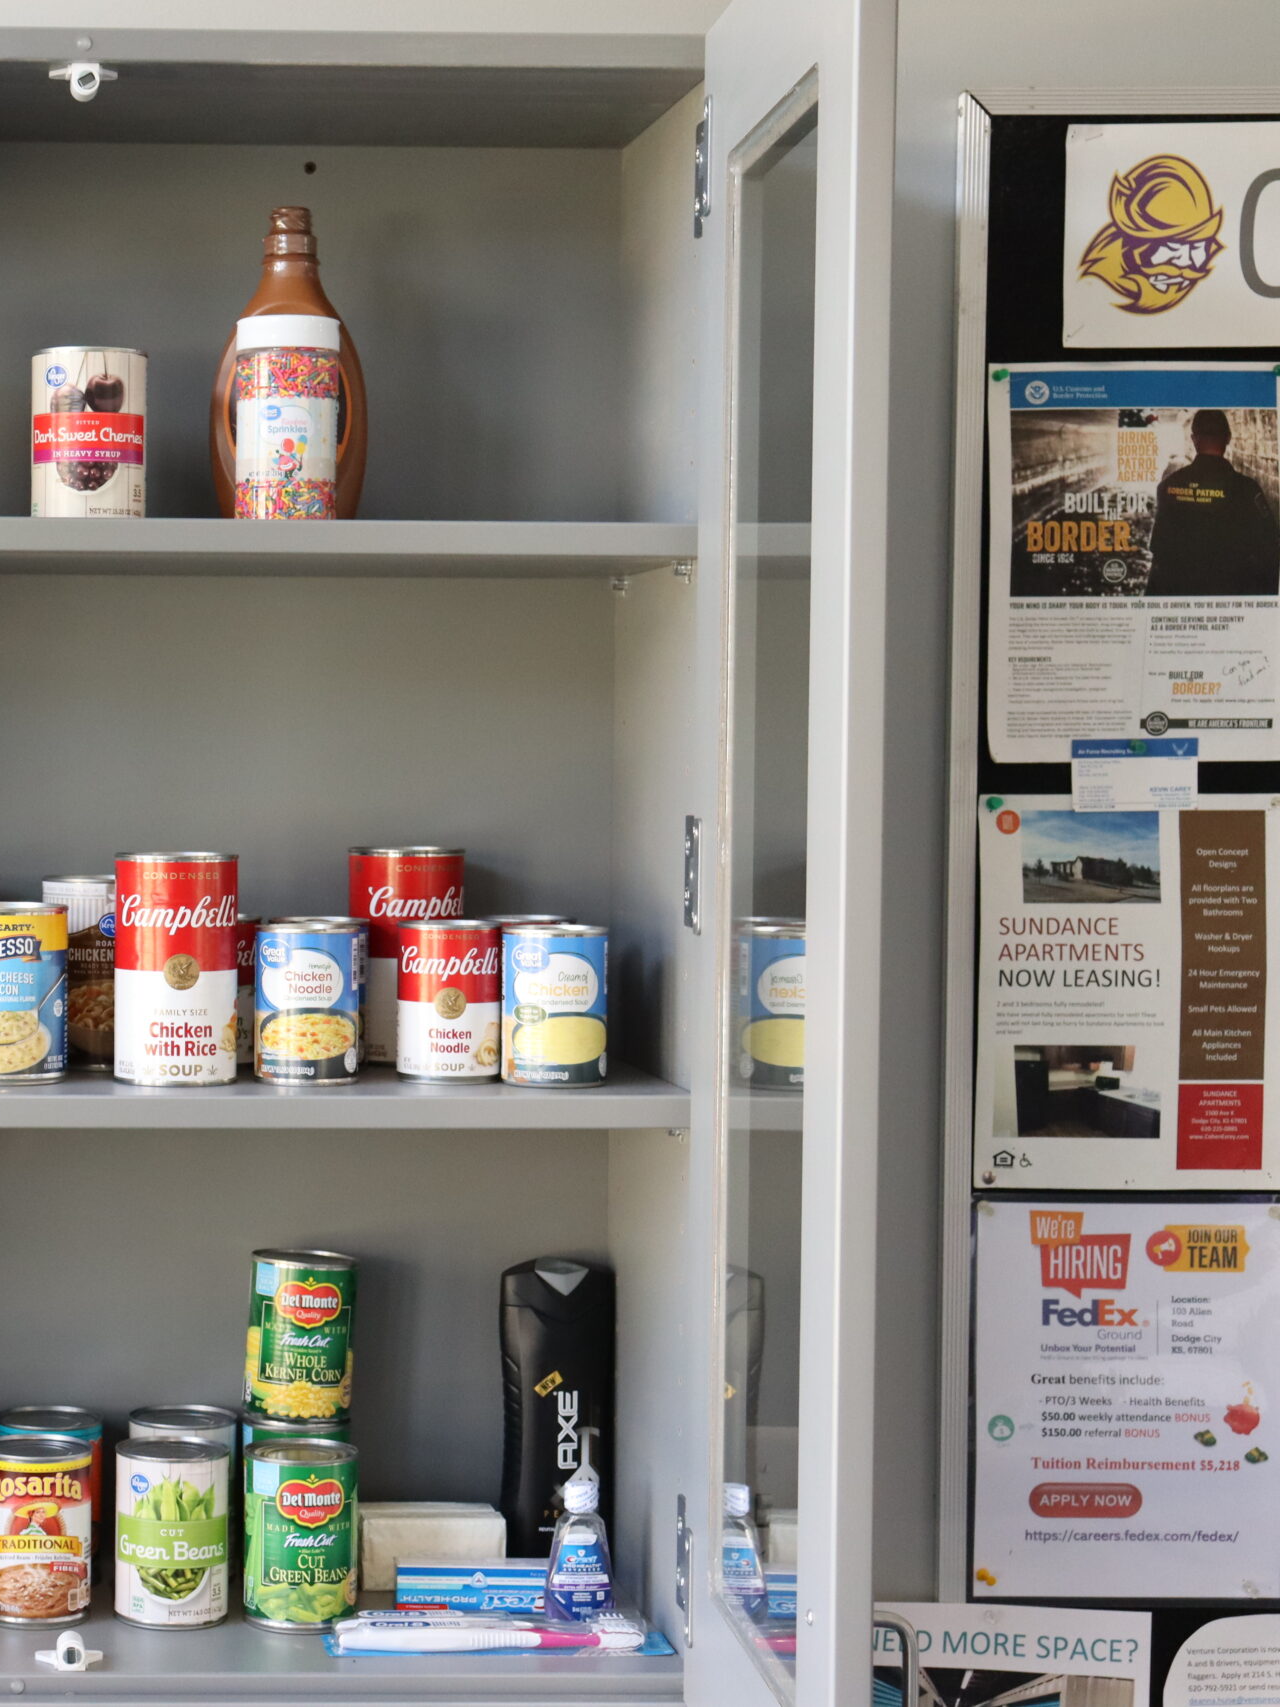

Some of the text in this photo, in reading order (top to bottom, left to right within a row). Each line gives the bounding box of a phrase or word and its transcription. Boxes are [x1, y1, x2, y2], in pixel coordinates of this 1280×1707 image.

[267, 424, 308, 434] Sprinkles
[34, 427, 143, 445] Dark Sweet Cherries
[1117, 445, 1159, 457] BORDER
[1117, 458, 1158, 470] PATROL
[1168, 487, 1225, 498] BORDER PATROL
[1064, 493, 1148, 513] BUILT FOR
[1172, 682, 1221, 695] BORDER?
[1196, 848, 1248, 857] Open Concept
[1209, 860, 1237, 869] Designs
[143, 872, 219, 880] CONDENSED
[1188, 896, 1221, 905] provided
[121, 894, 235, 935] Campbell's
[1203, 908, 1243, 916] Bathrooms
[999, 917, 1119, 936] SUNDANCE
[68, 949, 114, 961] CHICKEN
[263, 945, 286, 957] Great
[998, 943, 1145, 961] APARTMENTS
[1208, 945, 1240, 954] Hookups
[401, 945, 500, 981] Campbell's
[0, 972, 35, 984] CHEESE
[285, 971, 332, 982] Chicken
[998, 969, 1161, 987] NOW LEASING!
[289, 983, 332, 994] Noodle
[528, 983, 589, 997] Chicken
[1199, 981, 1247, 989] Maintenance
[154, 1008, 208, 1016] FAMILY SIZE
[149, 1022, 212, 1037] Chicken
[428, 1028, 472, 1040] Chicken
[1192, 1029, 1252, 1037] All Main Kitchen
[144, 1041, 217, 1056] with Rice
[430, 1043, 470, 1053] Noodle
[1202, 1041, 1241, 1050] Appliances
[1206, 1053, 1238, 1061] Included
[159, 1064, 203, 1076] SOUP
[434, 1063, 465, 1072] SOUP
[1036, 1216, 1074, 1239] We're
[1187, 1230, 1238, 1244] JOIN OUR
[1049, 1245, 1122, 1280] HIRING
[1187, 1246, 1238, 1268] TEAM
[281, 1293, 338, 1308] Del Monte
[1042, 1299, 1139, 1327] FedEx
[1097, 1329, 1142, 1340] Ground
[1171, 1334, 1222, 1344] Dodge City
[1040, 1344, 1136, 1352] Unbox Your Potential
[285, 1353, 327, 1368] WHOLE
[265, 1363, 341, 1381] KERNEL CORN
[539, 1374, 558, 1392] NEW
[1031, 1373, 1165, 1386] Great benefits include:
[1045, 1396, 1205, 1407] PTO/3 Weeks Health Benefits
[1041, 1411, 1211, 1423] $50.00 weekly attendance BONUS
[557, 1390, 579, 1470] AXE
[1041, 1428, 1160, 1438] $150.00 referral BONUS
[1031, 1457, 1240, 1472] Tuition Reimbursement $5,218
[282, 1492, 341, 1506] Del Monte
[1039, 1495, 1132, 1507] APPLY NOW
[299, 1510, 325, 1519] Quality
[160, 1528, 184, 1537] CUT
[266, 1522, 351, 1532] MADE WITH
[1025, 1530, 1240, 1543] https://careers.fedex.com/fedex/
[120, 1534, 224, 1561] Green Beans
[297, 1555, 326, 1568] CUT
[269, 1567, 348, 1583] GREEN BEANS
[942, 1630, 1027, 1658] MORE
[1036, 1635, 1139, 1664] SPACE?
[1186, 1647, 1214, 1655] Venture
[1217, 1646, 1259, 1655] Corporation
